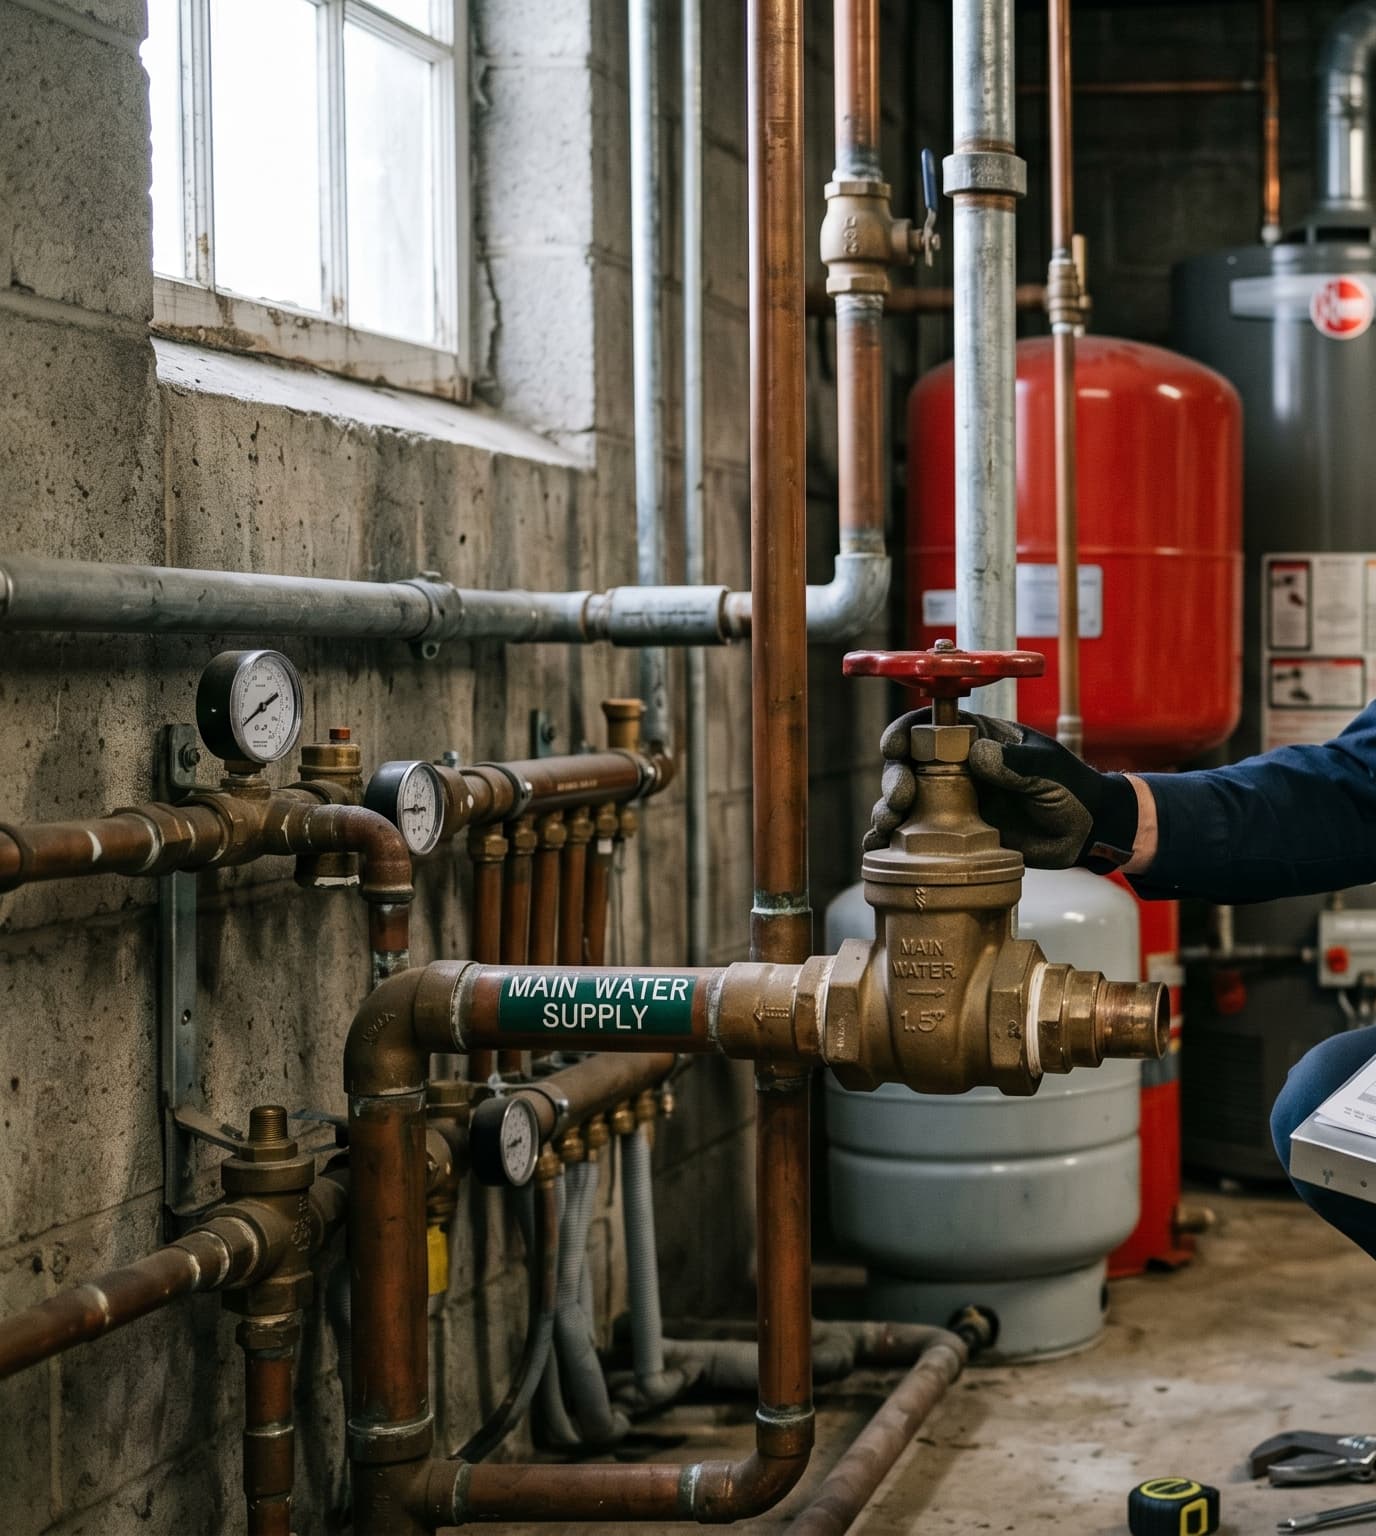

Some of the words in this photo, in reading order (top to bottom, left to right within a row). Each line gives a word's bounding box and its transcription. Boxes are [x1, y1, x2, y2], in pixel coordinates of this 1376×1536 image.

[900, 938, 945, 957] MAIN
[891, 960, 957, 980] WATER
[507, 975, 579, 999] MAIN
[594, 975, 689, 1001] WATER
[542, 1002, 649, 1030] SUPPLY
